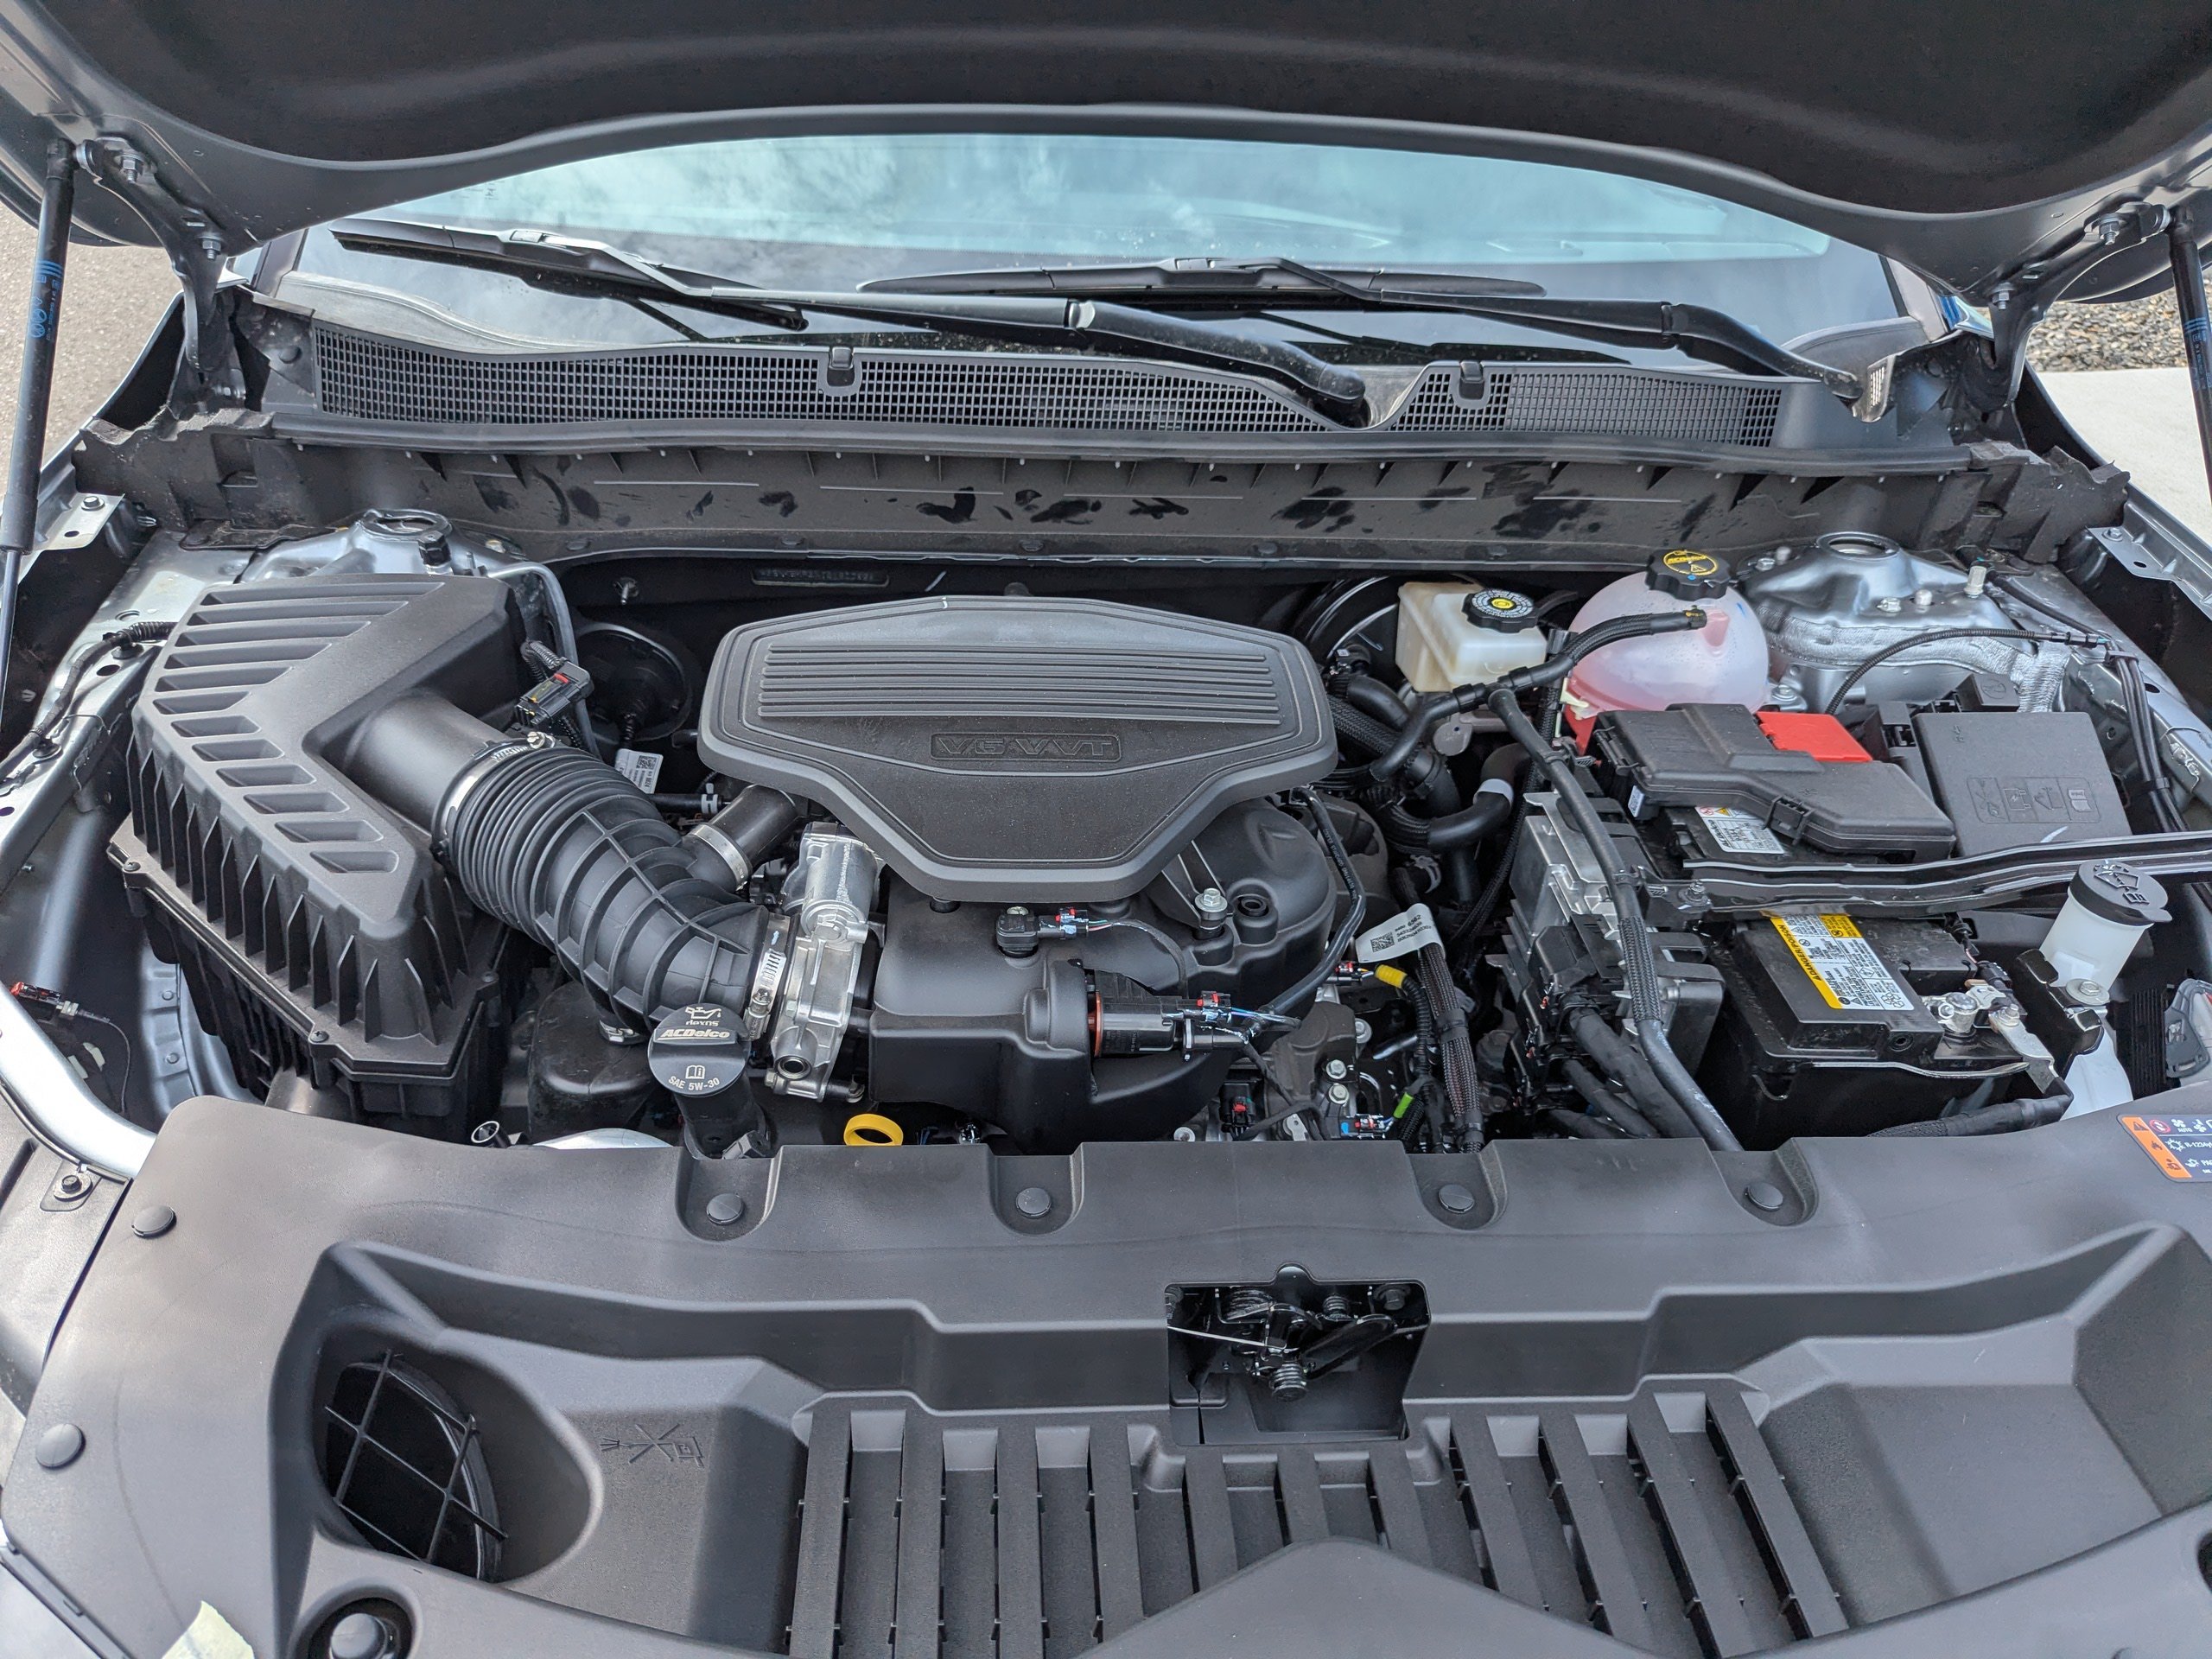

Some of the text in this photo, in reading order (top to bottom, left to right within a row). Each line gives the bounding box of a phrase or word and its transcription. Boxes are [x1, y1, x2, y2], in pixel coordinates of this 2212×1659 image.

[938, 738, 1112, 756] V6 VVT
[660, 1028, 730, 1038] ACDelco
[668, 1075, 721, 1090] SAE 5W-30
